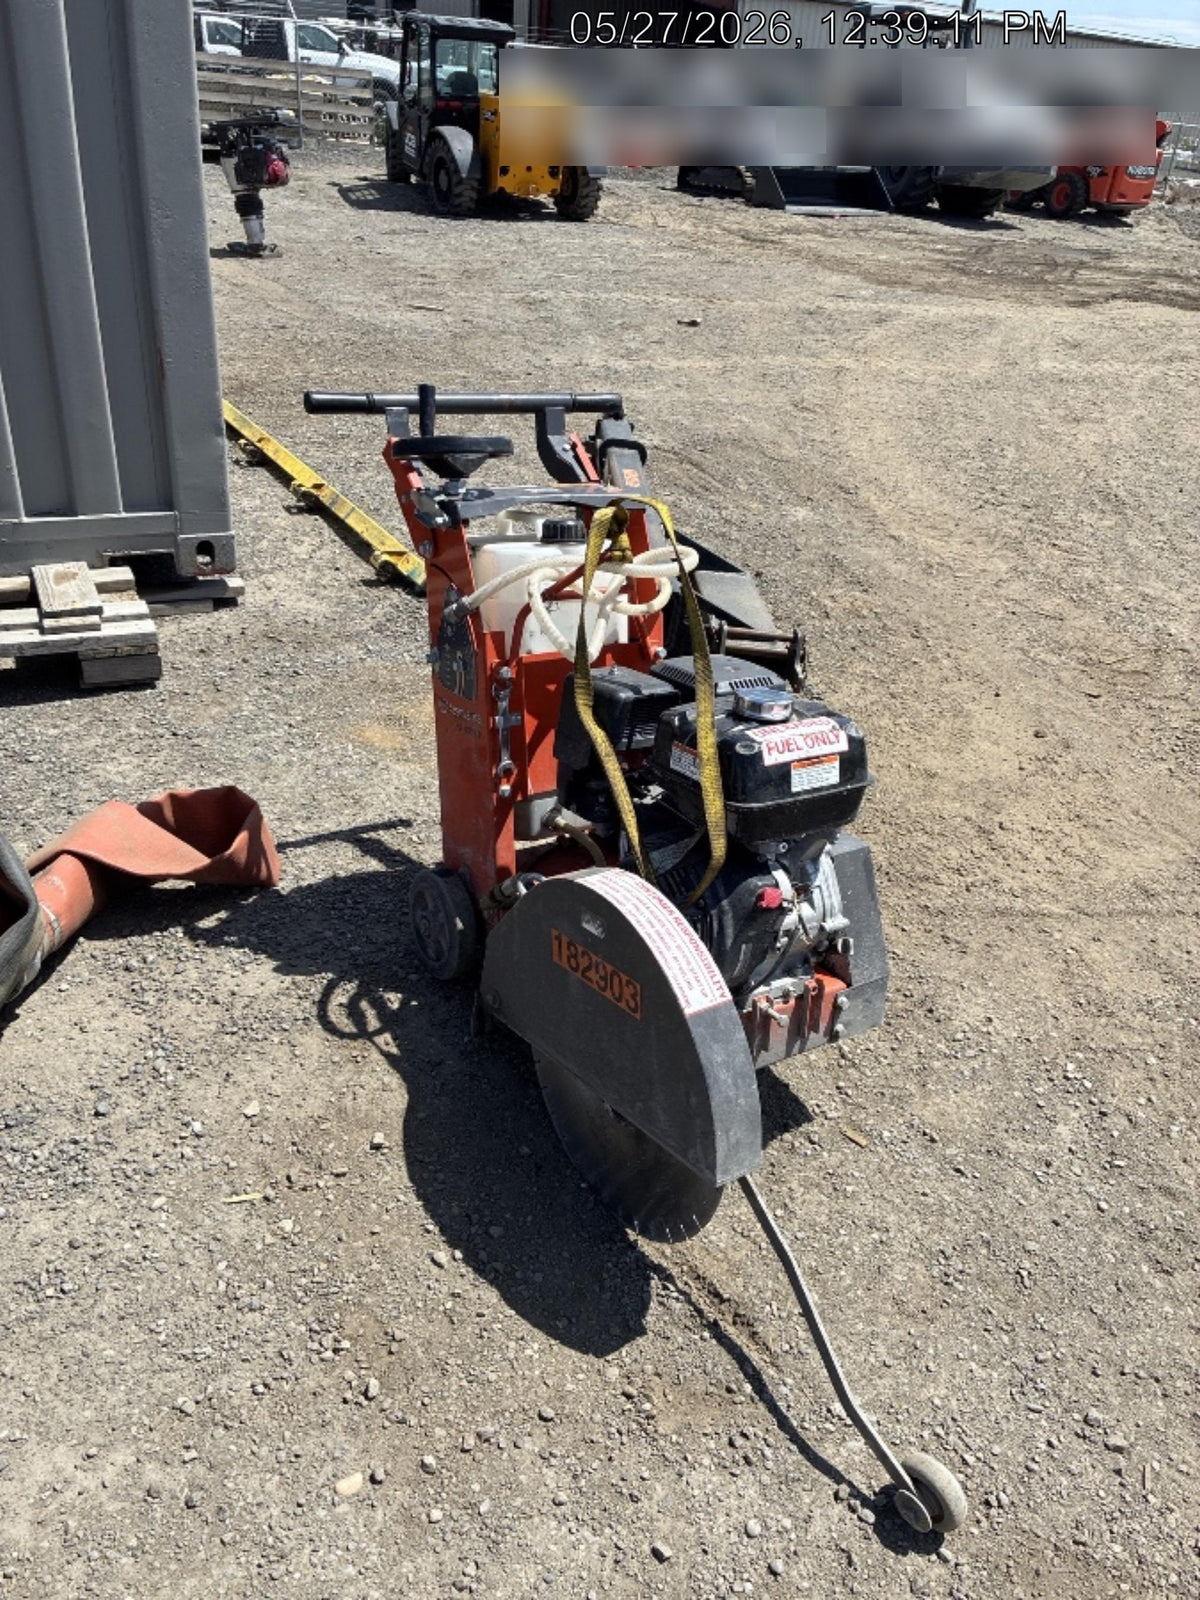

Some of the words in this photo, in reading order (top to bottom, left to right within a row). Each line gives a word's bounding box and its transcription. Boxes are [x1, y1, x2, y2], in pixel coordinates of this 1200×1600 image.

[766, 737, 803, 756] FUEL
[803, 730, 841, 749] ONLY
[553, 933, 640, 1015] 182903
[670, 915, 728, 1000] RESPONSIBILITY
